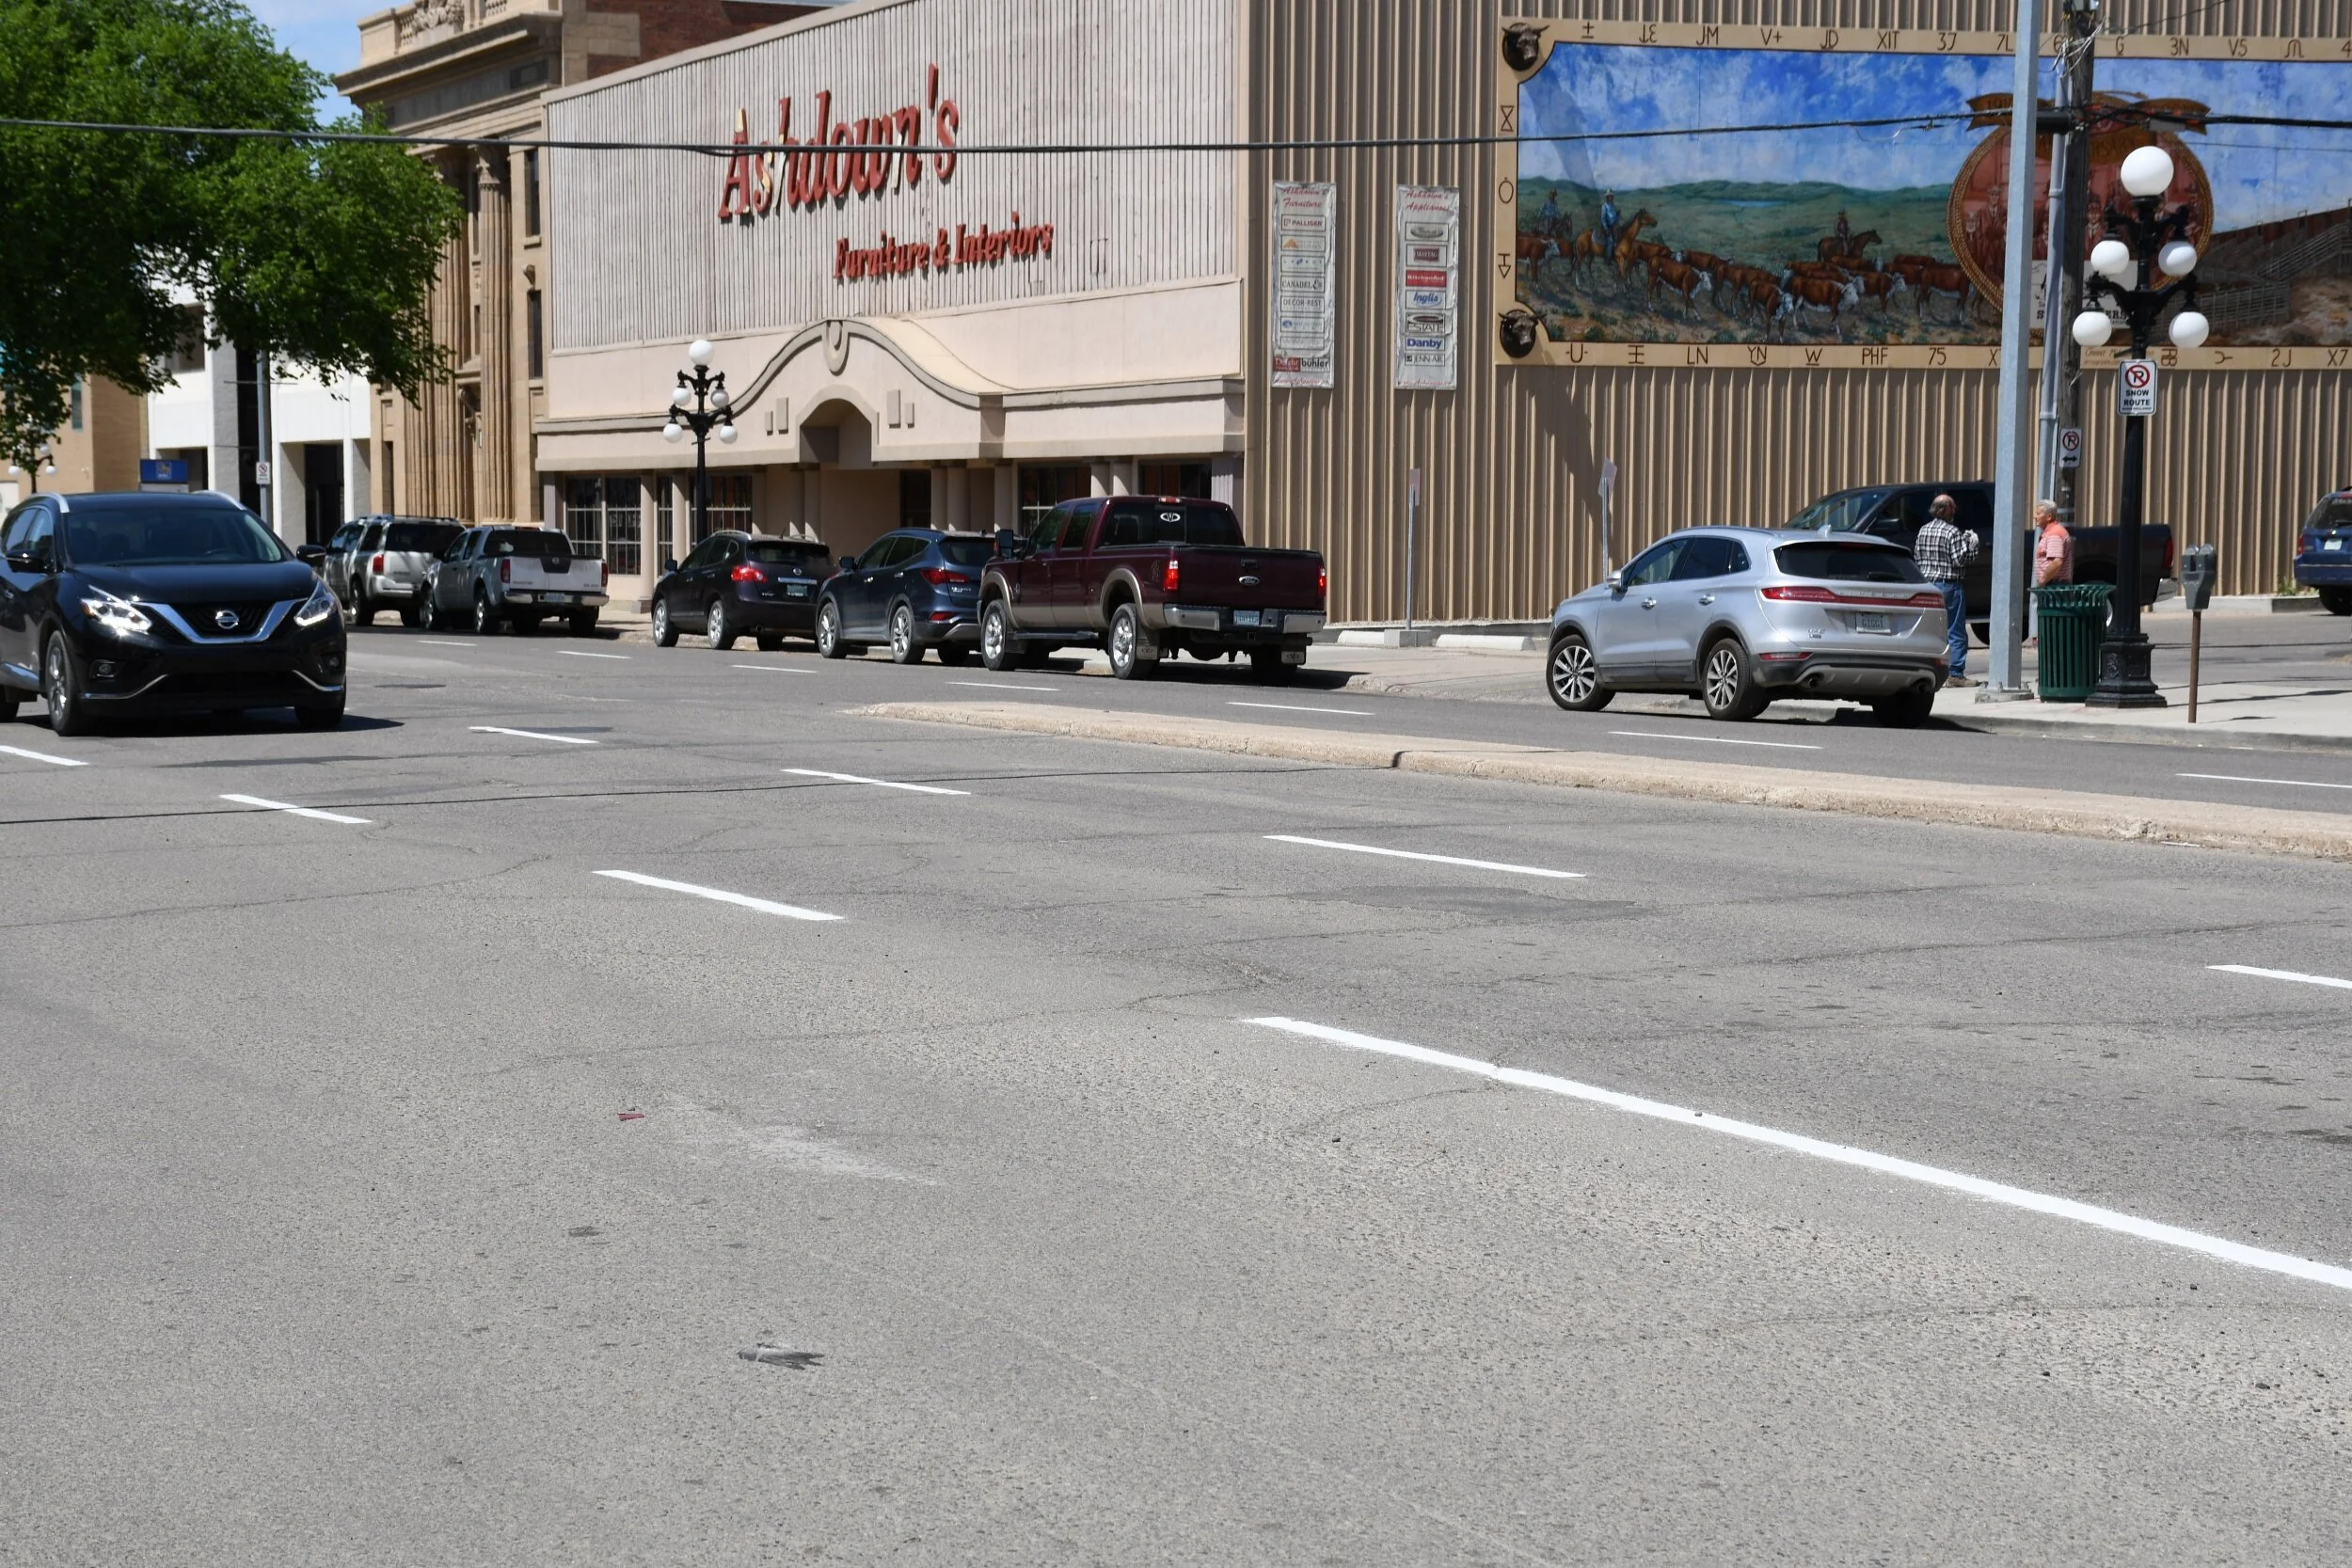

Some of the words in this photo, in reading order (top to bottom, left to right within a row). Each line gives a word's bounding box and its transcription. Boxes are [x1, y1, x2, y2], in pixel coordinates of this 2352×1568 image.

[718, 62, 960, 218] Ashdown's
[834, 229, 930, 279] Furniture
[932, 228, 950, 267] &
[953, 211, 1054, 264] Interiors
[1406, 338, 1442, 349] Danby
